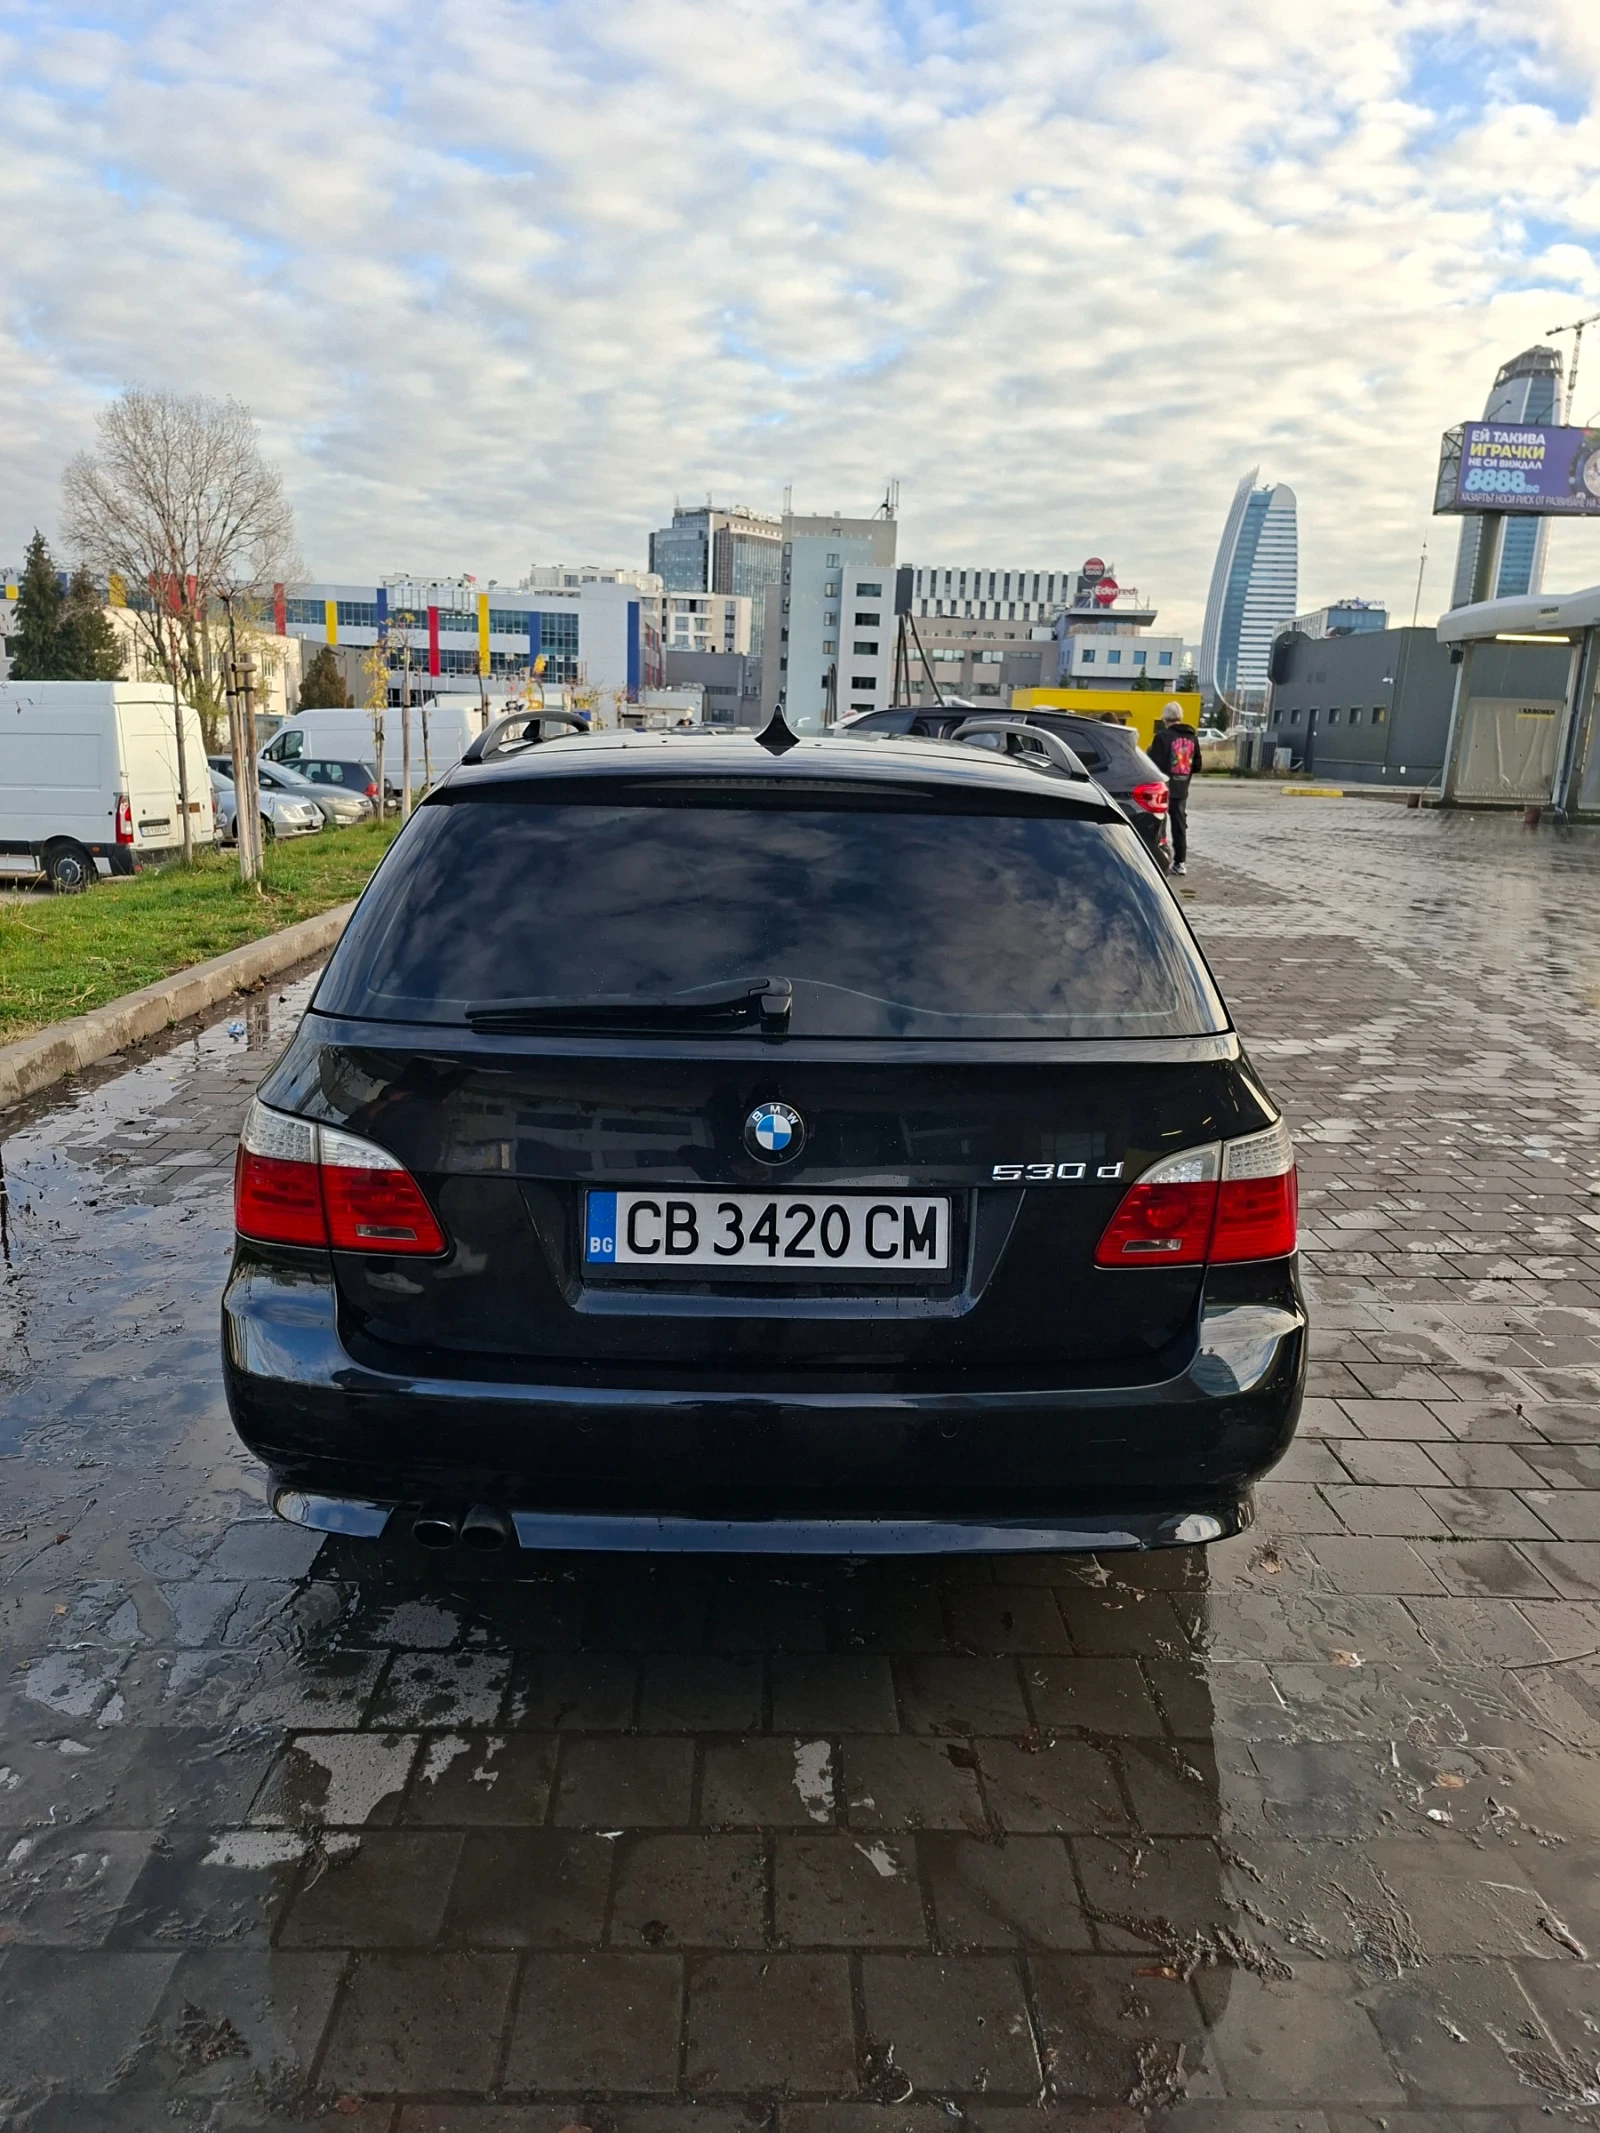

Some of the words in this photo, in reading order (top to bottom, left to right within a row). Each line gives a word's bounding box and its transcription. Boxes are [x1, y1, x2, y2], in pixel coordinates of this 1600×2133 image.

[1471, 429, 1490, 443] ЕЙ
[1493, 432, 1546, 445] ТАКИВА
[1469, 443, 1545, 459] ИГРАЧКИ
[1468, 458, 1482, 467] НЕ
[1483, 459, 1498, 467] СИ
[1498, 460, 1542, 470] ВИЖДАЛ
[1495, 494, 1516, 505] НОСИ
[1535, 497, 1546, 506] ОТ
[1095, 585, 1136, 596] Edenred
[752, 1105, 798, 1125] BMW
[992, 1162, 1087, 1181] 530
[1096, 1161, 1125, 1179] d
[626, 1200, 700, 1255] CB
[713, 1202, 851, 1258] 3420
[865, 1205, 937, 1260] CM
[589, 1237, 613, 1254] BG
